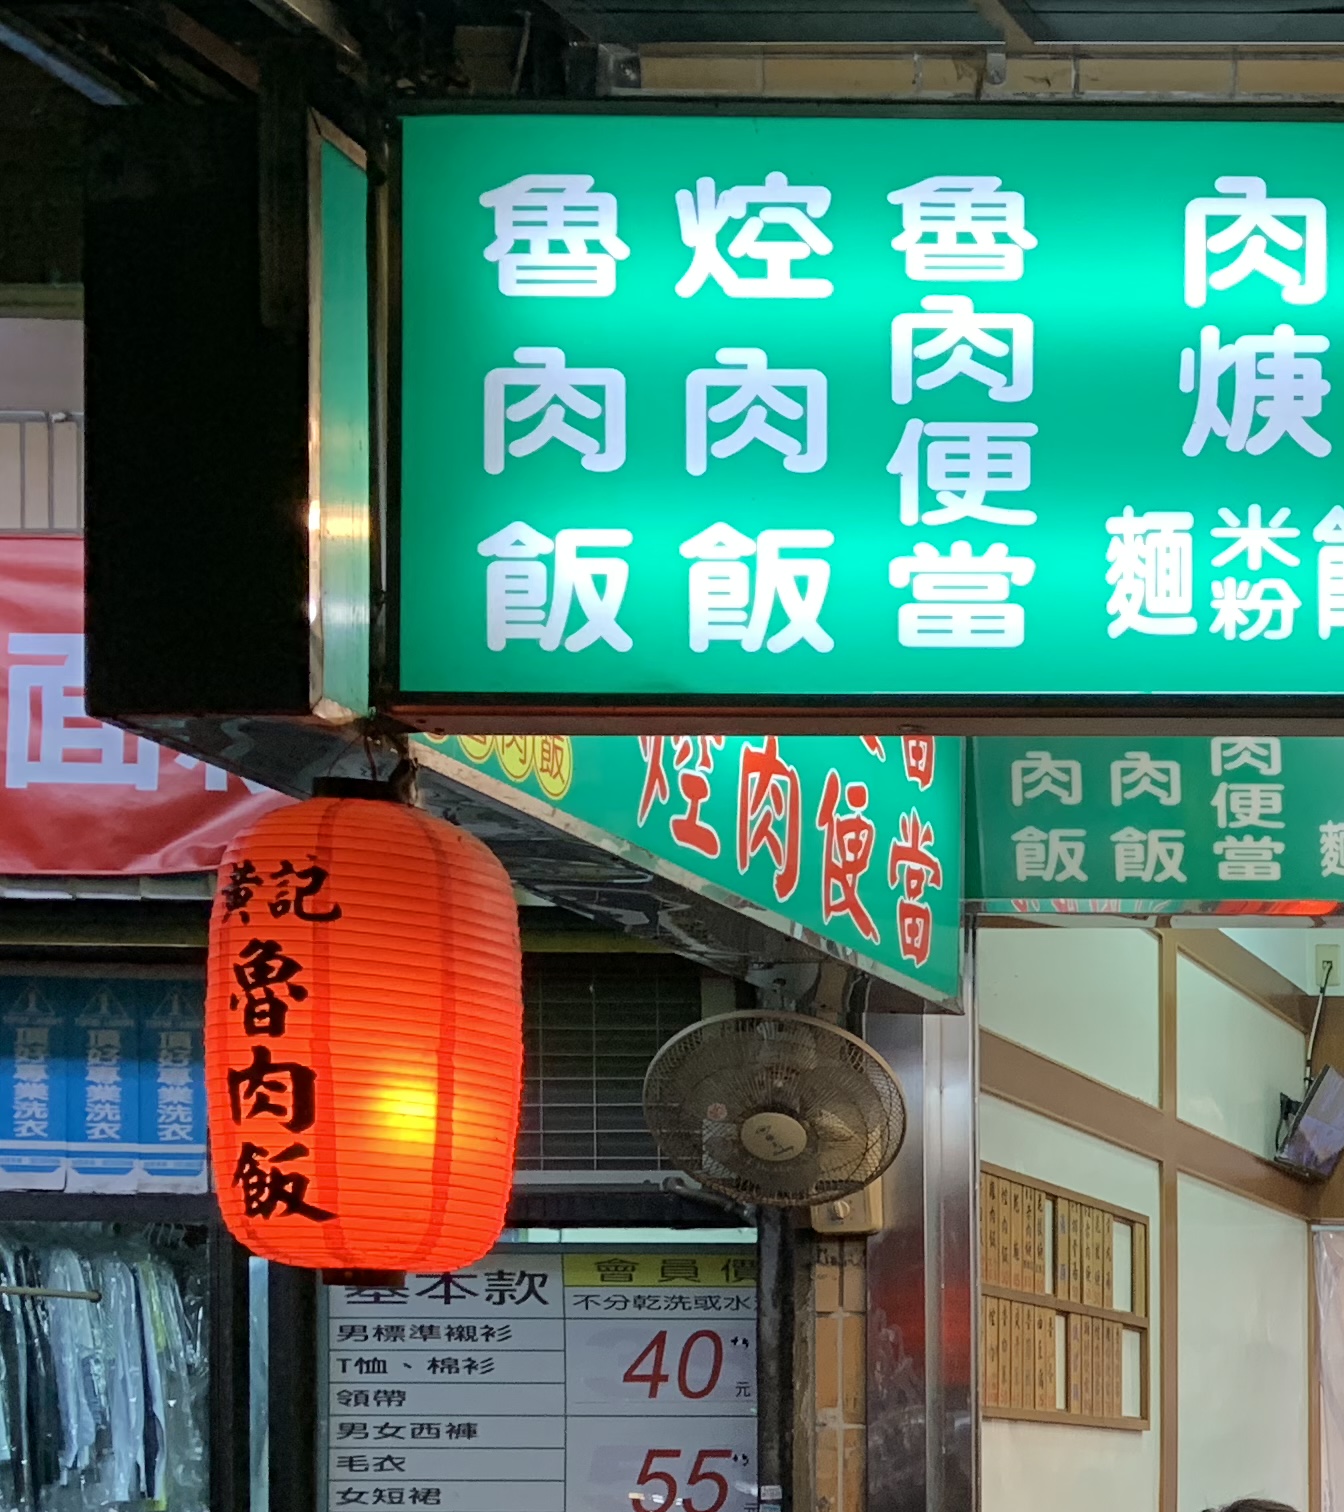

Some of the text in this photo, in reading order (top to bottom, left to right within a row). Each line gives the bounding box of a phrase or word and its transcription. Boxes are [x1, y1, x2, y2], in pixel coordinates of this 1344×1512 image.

[478, 172, 633, 654] 魯肉飯
[673, 171, 836, 654] 焢肉飯
[886, 174, 1041, 650] 魯肉便當
[1104, 505, 1197, 641] 麵
[1209, 505, 1300, 641] 米粉
[1011, 751, 1089, 882] 肉飯
[1110, 751, 1187, 883] 肉飯
[1211, 736, 1285, 882] 肉便當
[221, 858, 342, 924] 黃記
[229, 938, 338, 1221] 魯肉飯
[336, 1324, 513, 1342] 男標準襯衫
[573, 1294, 757, 1311] 不分乾洗或水
[336, 1390, 407, 1408] 領帶
[623, 1329, 751, 1399] 40 元
[336, 1422, 479, 1441] 男女西褲
[336, 1455, 406, 1473] 毛衣
[336, 1487, 441, 1506] 女短裙
